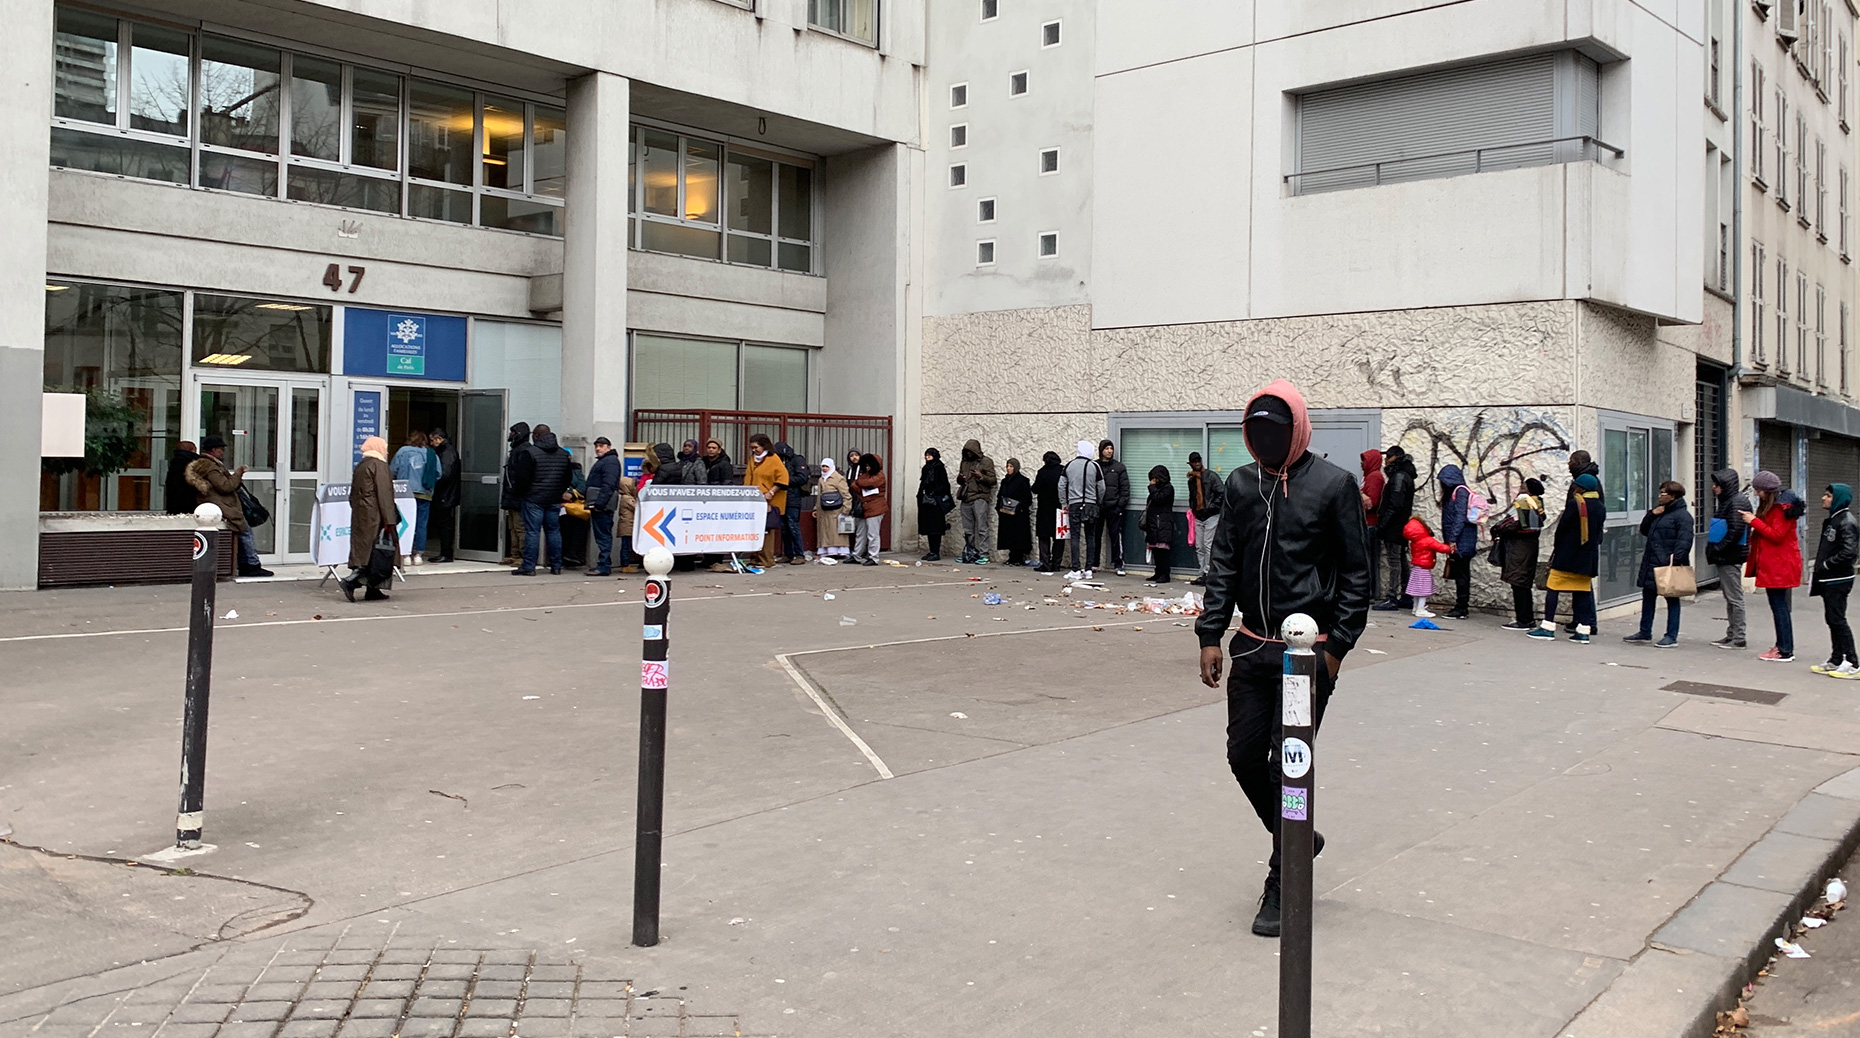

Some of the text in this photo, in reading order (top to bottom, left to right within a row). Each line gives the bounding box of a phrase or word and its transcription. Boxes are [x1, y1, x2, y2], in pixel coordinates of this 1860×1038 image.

[323, 263, 365, 293] 47
[328, 487, 346, 496] VOUS
[647, 488, 760, 497] VOUS N'AVEZ PAS RENDEZ-VOUS
[696, 510, 755, 520] ESPACE NUMÉRIQUE
[695, 533, 759, 542] POINT INFORMATIONS
